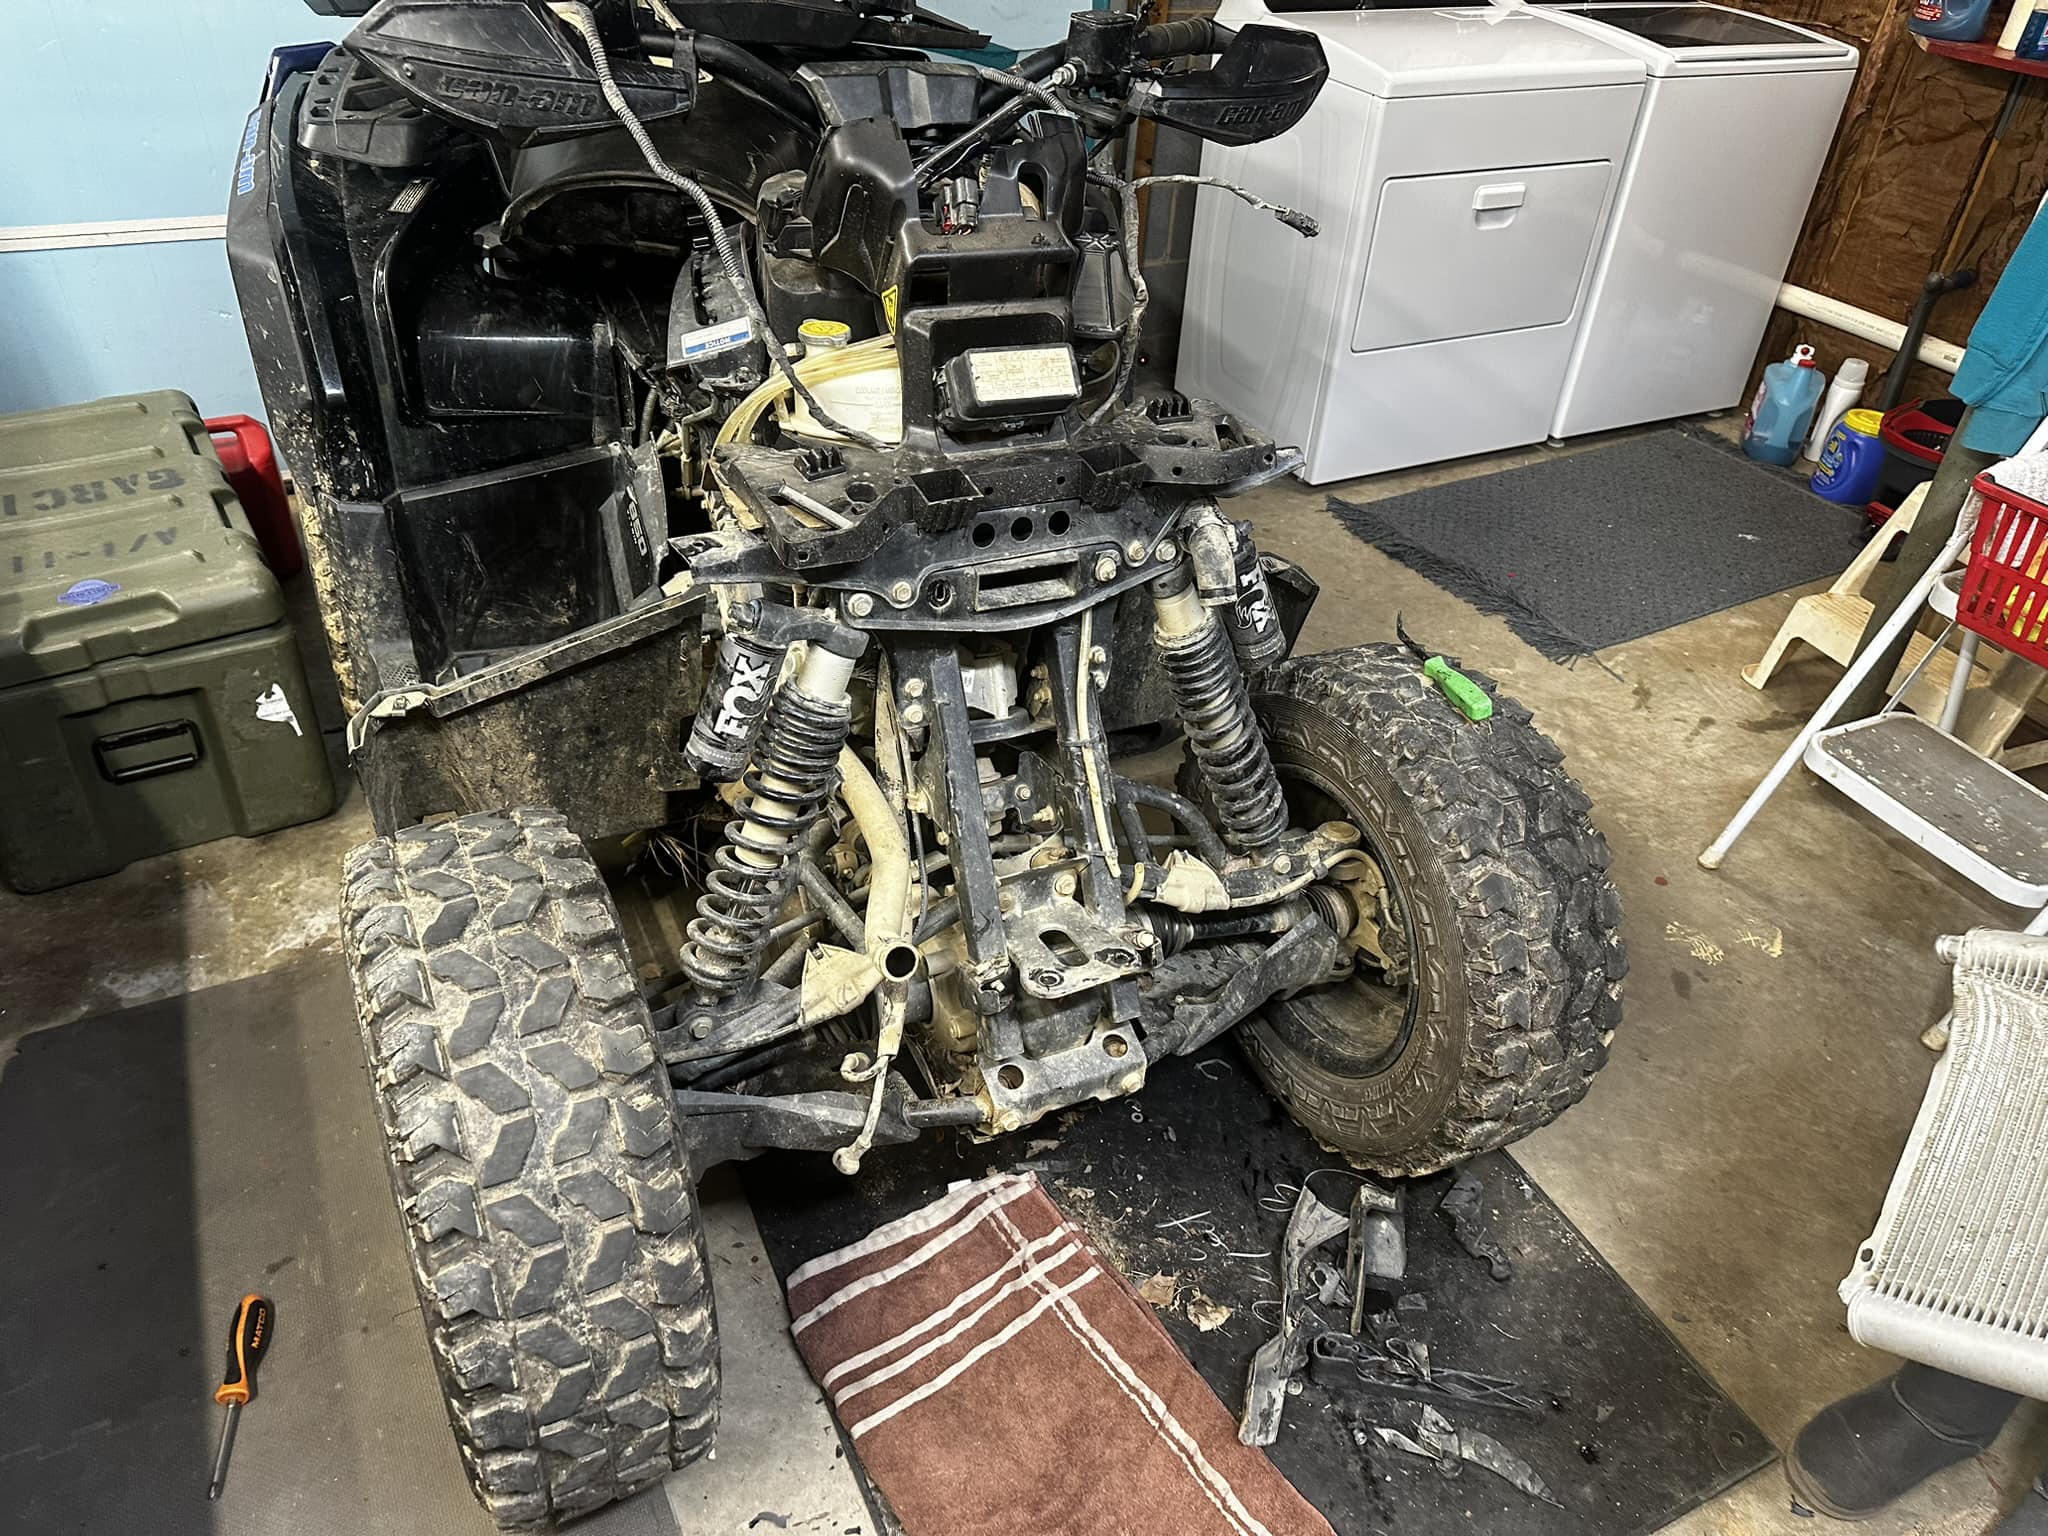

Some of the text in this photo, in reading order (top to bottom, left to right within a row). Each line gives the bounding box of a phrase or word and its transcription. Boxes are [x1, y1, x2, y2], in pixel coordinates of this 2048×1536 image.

[1235, 563, 1275, 633] FOX
[714, 654, 774, 739] FOX
[251, 1307, 265, 1349] MATCO
